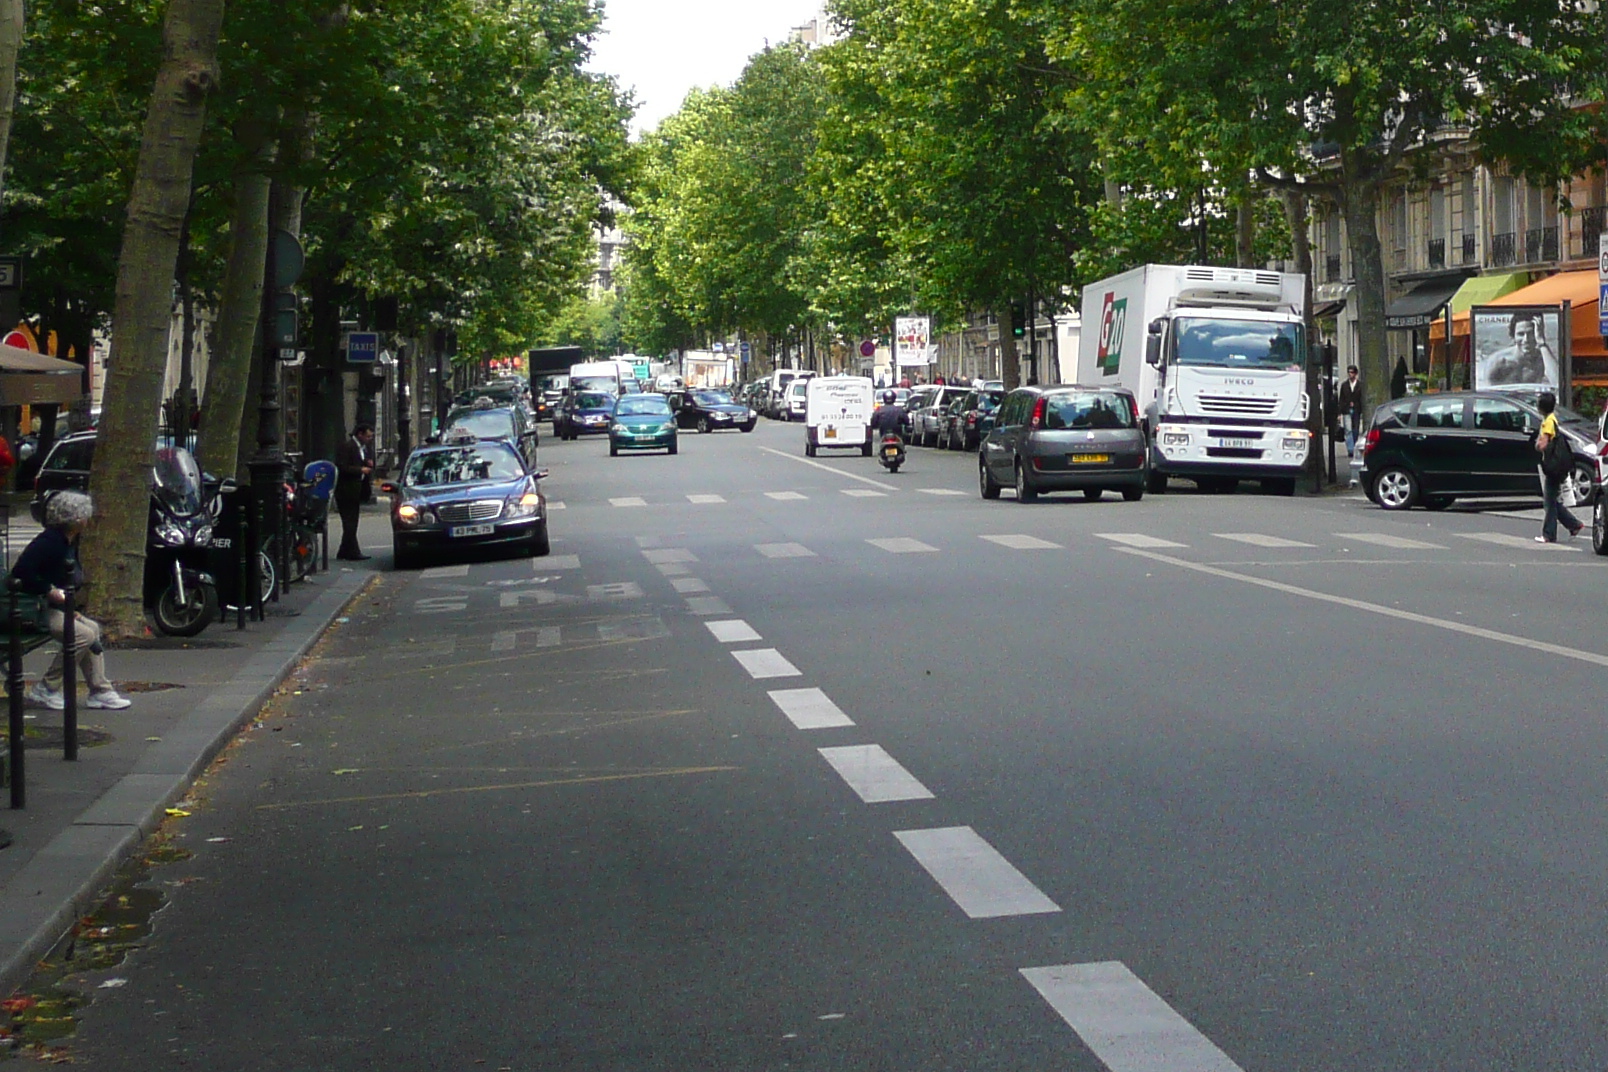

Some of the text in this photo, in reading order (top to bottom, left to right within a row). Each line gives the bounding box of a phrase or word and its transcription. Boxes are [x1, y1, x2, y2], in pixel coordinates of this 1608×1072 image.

[1478, 316, 1511, 324] CHANEL
[350, 343, 375, 351] TAXIS
[1224, 378, 1254, 386] IVECO
